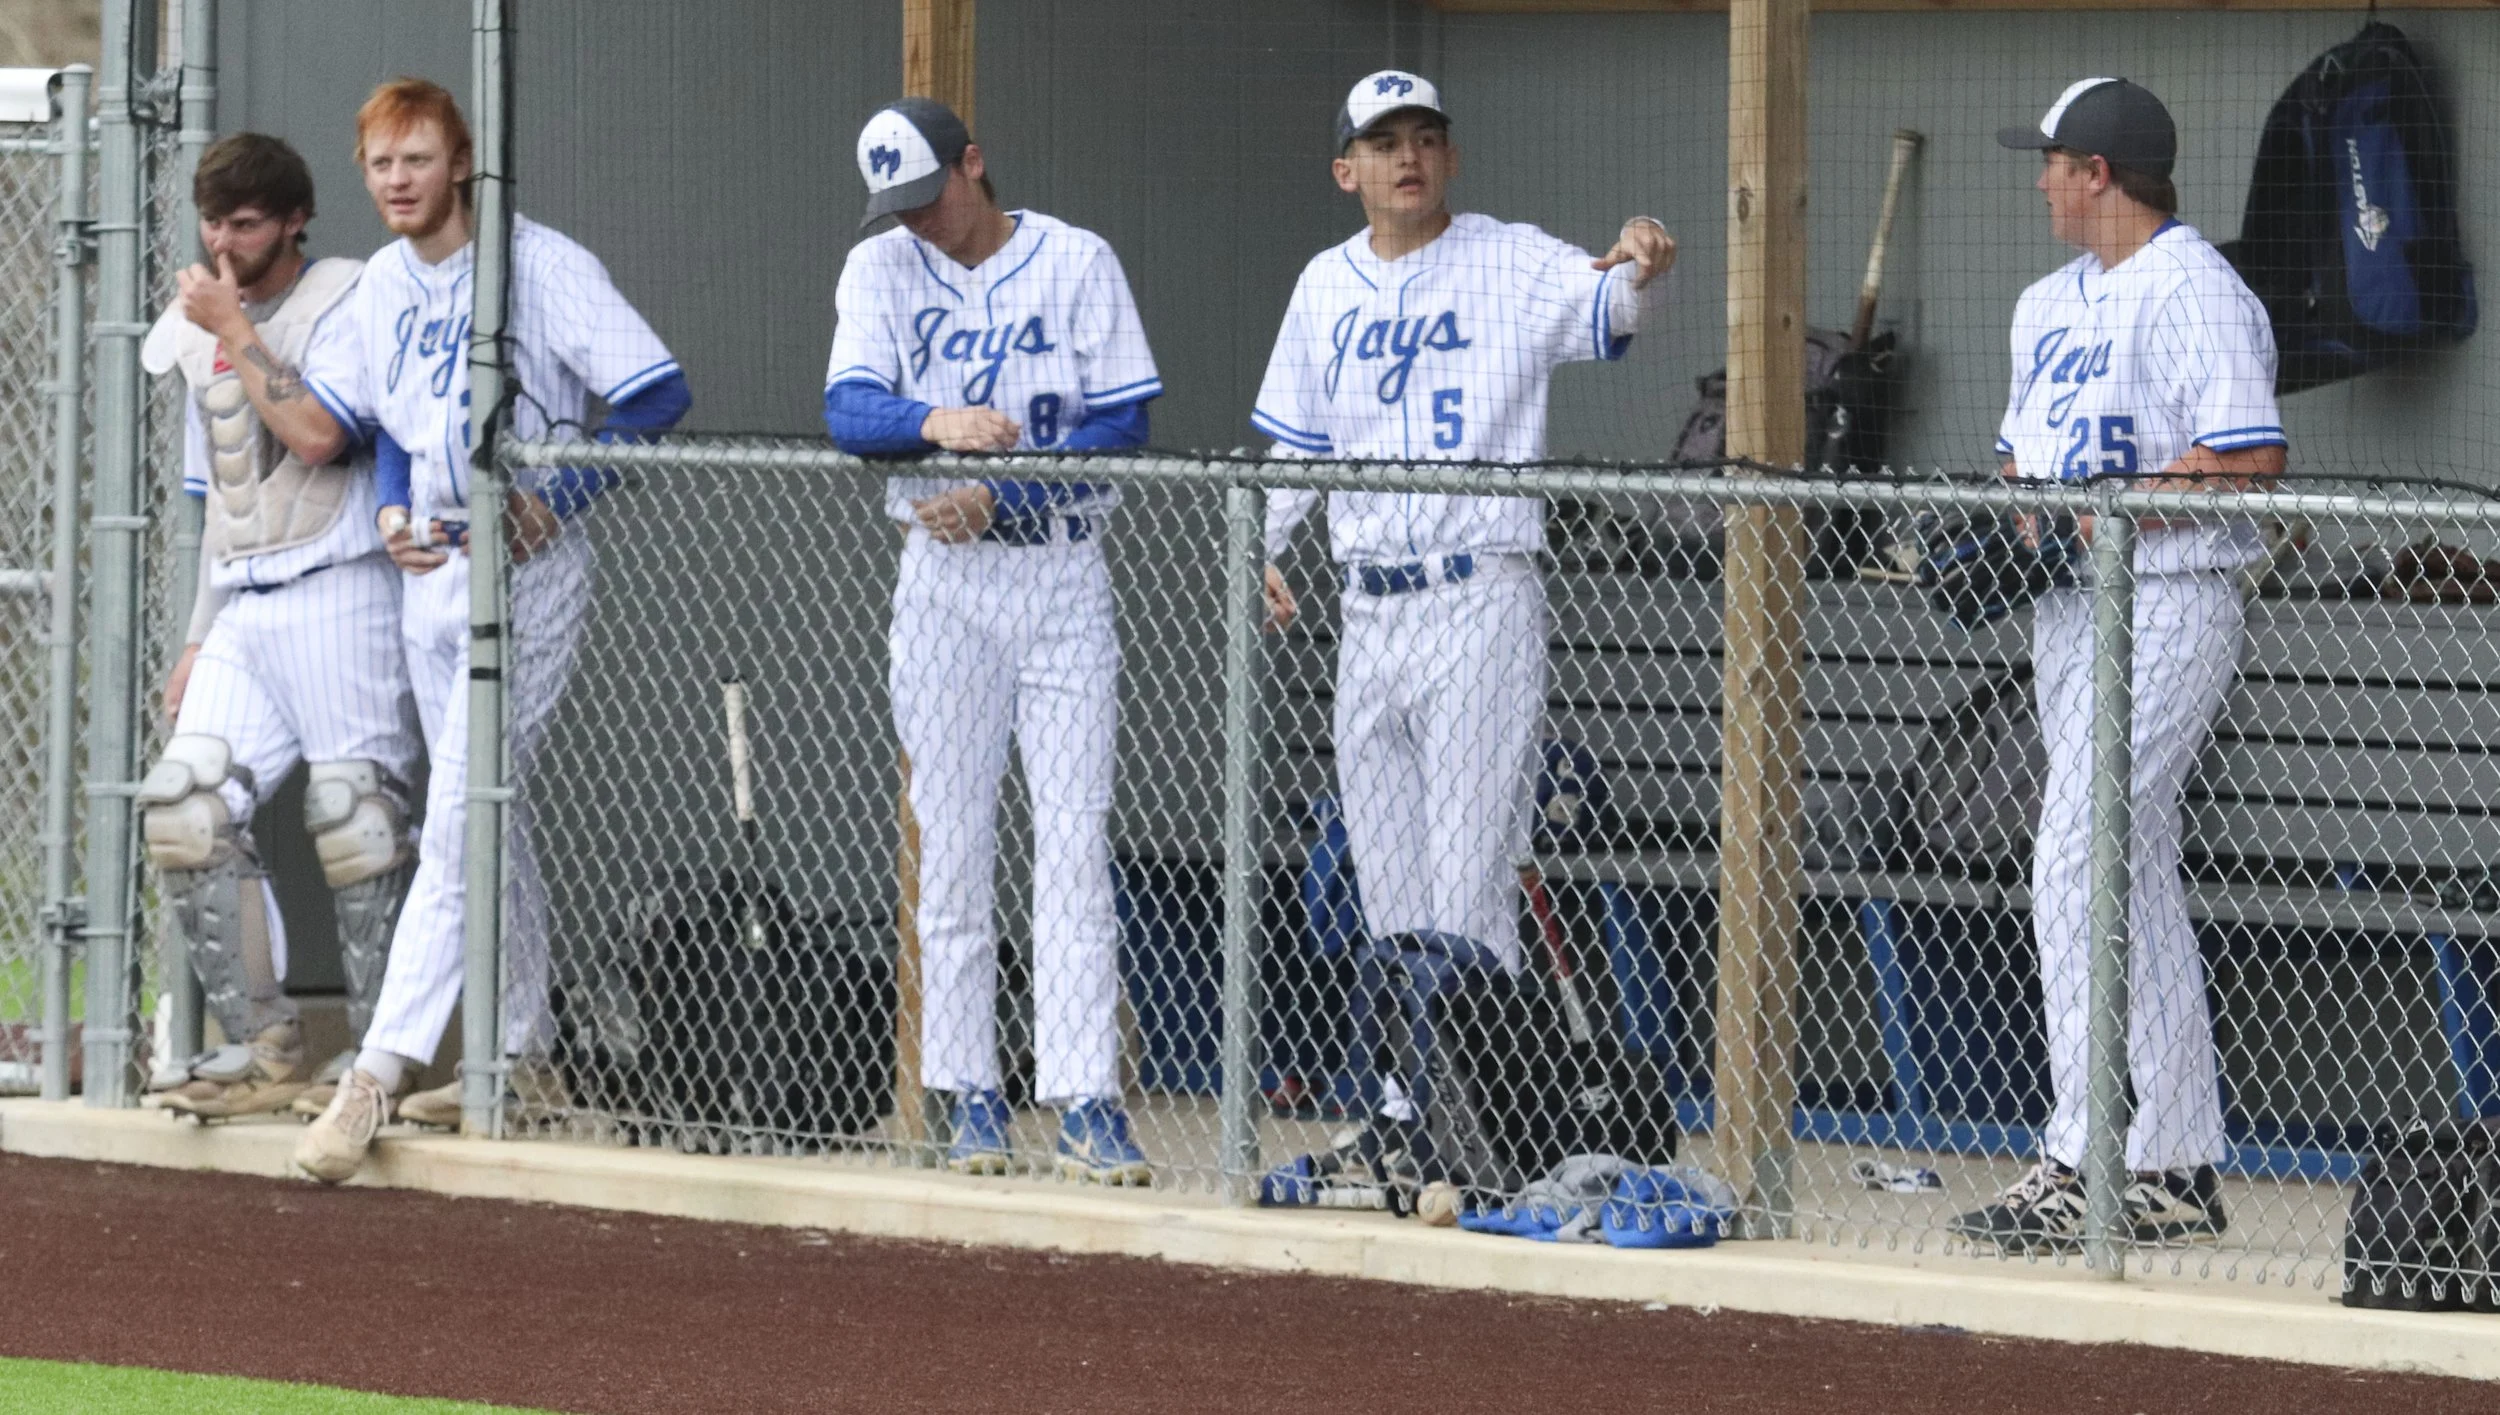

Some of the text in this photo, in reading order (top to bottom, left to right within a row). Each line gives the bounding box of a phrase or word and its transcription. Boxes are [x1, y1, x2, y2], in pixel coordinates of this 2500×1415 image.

[387, 305, 471, 398] Jay
[911, 307, 1056, 406] Jays
[1325, 307, 1471, 404] Jays
[2017, 327, 2113, 428] Jays
[1029, 393, 1062, 448] 8
[1432, 388, 1463, 450] 5
[2062, 416, 2138, 477] 25
